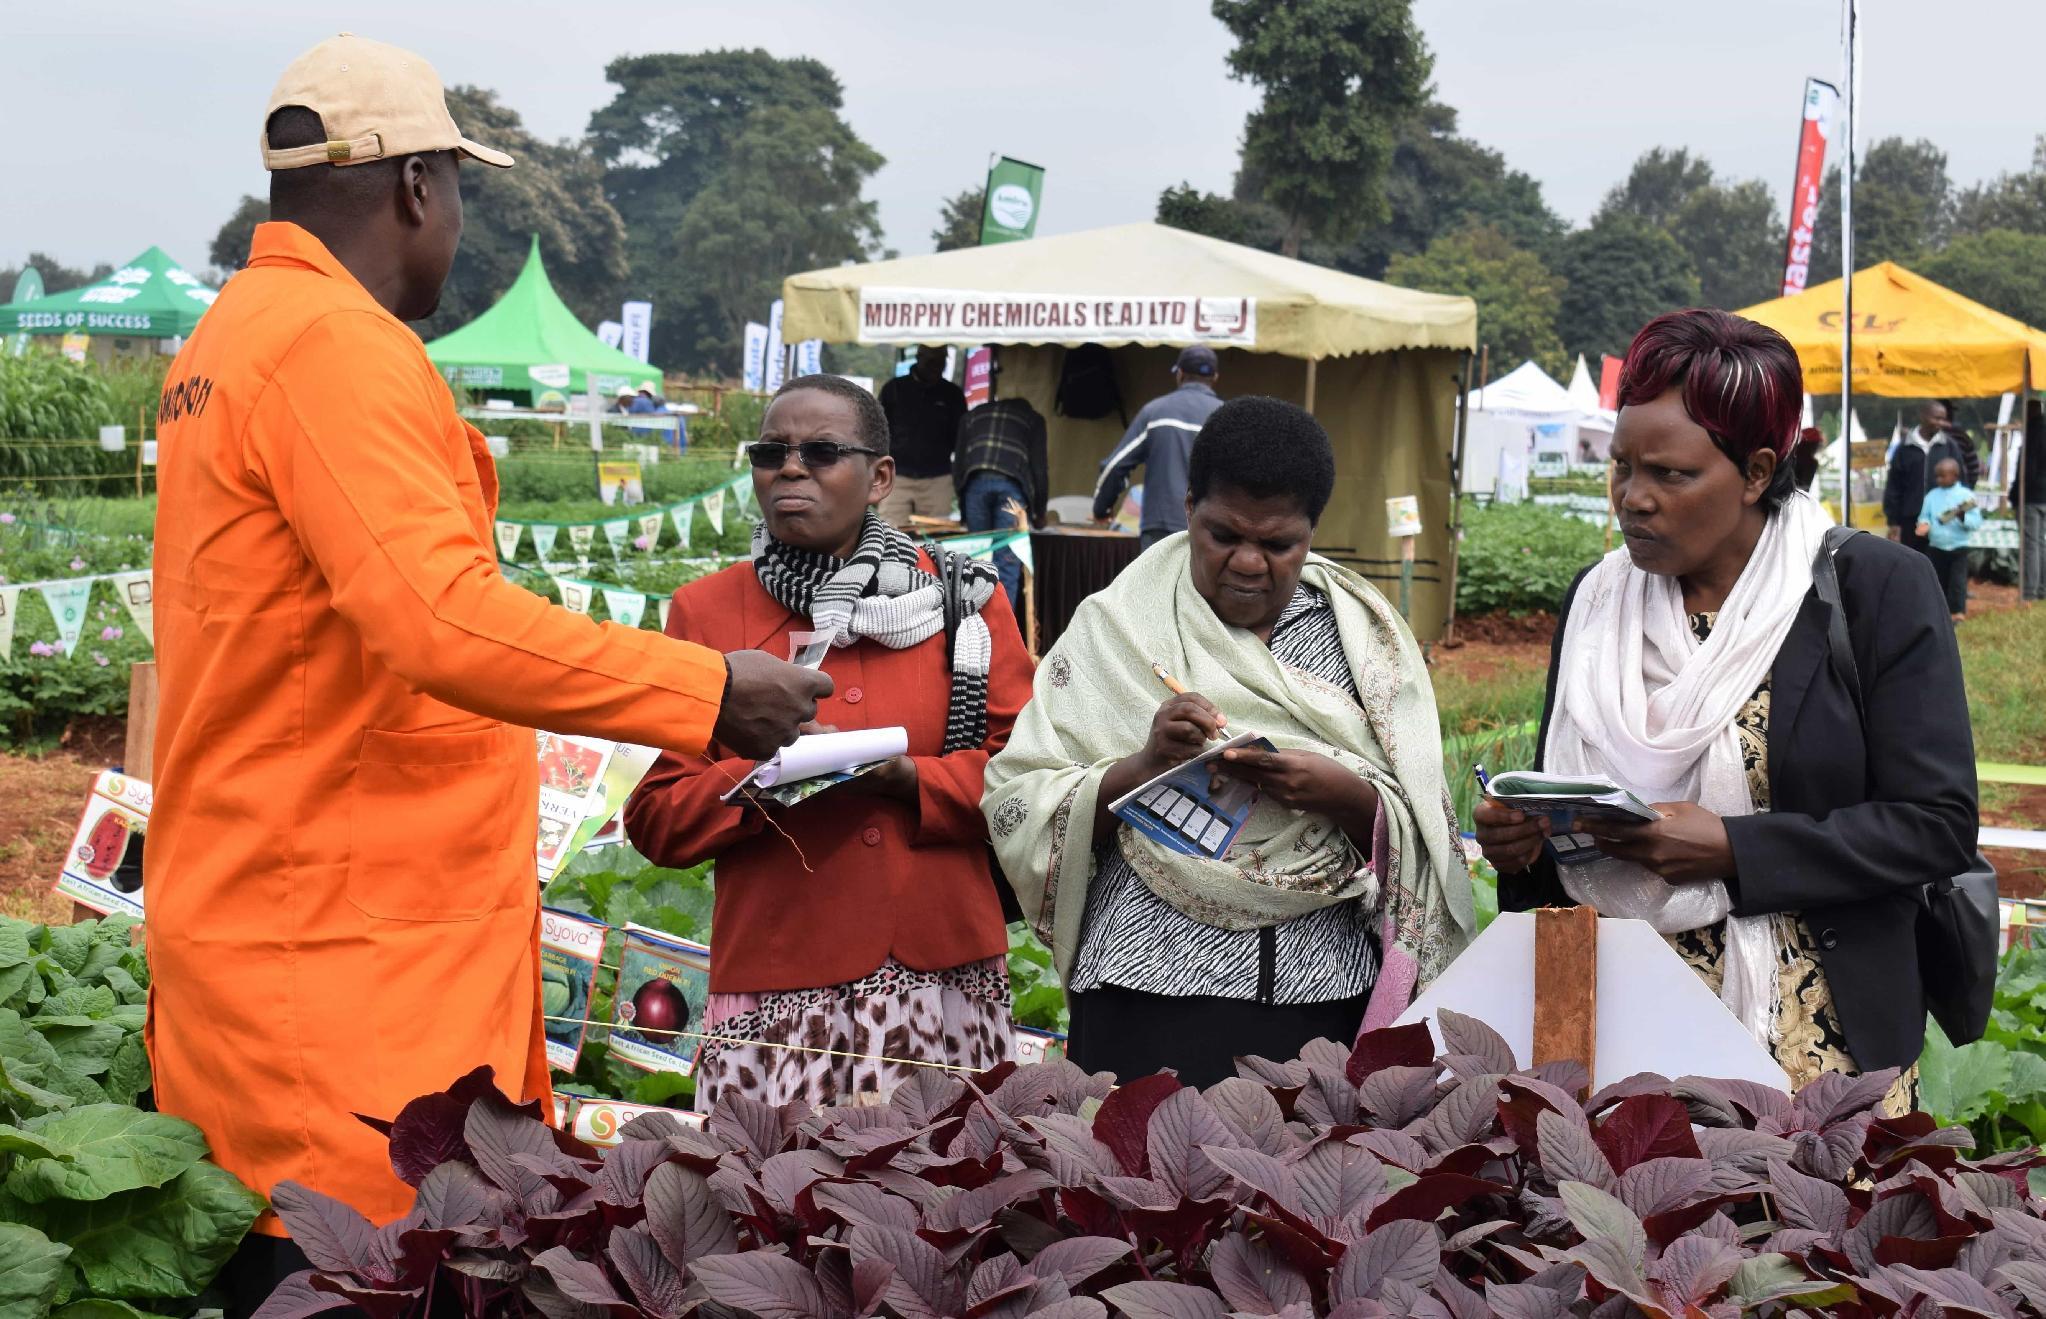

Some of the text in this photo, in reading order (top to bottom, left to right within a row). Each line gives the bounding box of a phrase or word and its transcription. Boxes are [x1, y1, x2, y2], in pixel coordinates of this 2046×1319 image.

[17, 312, 151, 330] SEEDS OF SUCCESS
[865, 303, 956, 328] MURPHY
[962, 302, 1087, 327] CHEMICALS
[1149, 301, 1186, 325] LTD
[545, 917, 589, 945] Syova
